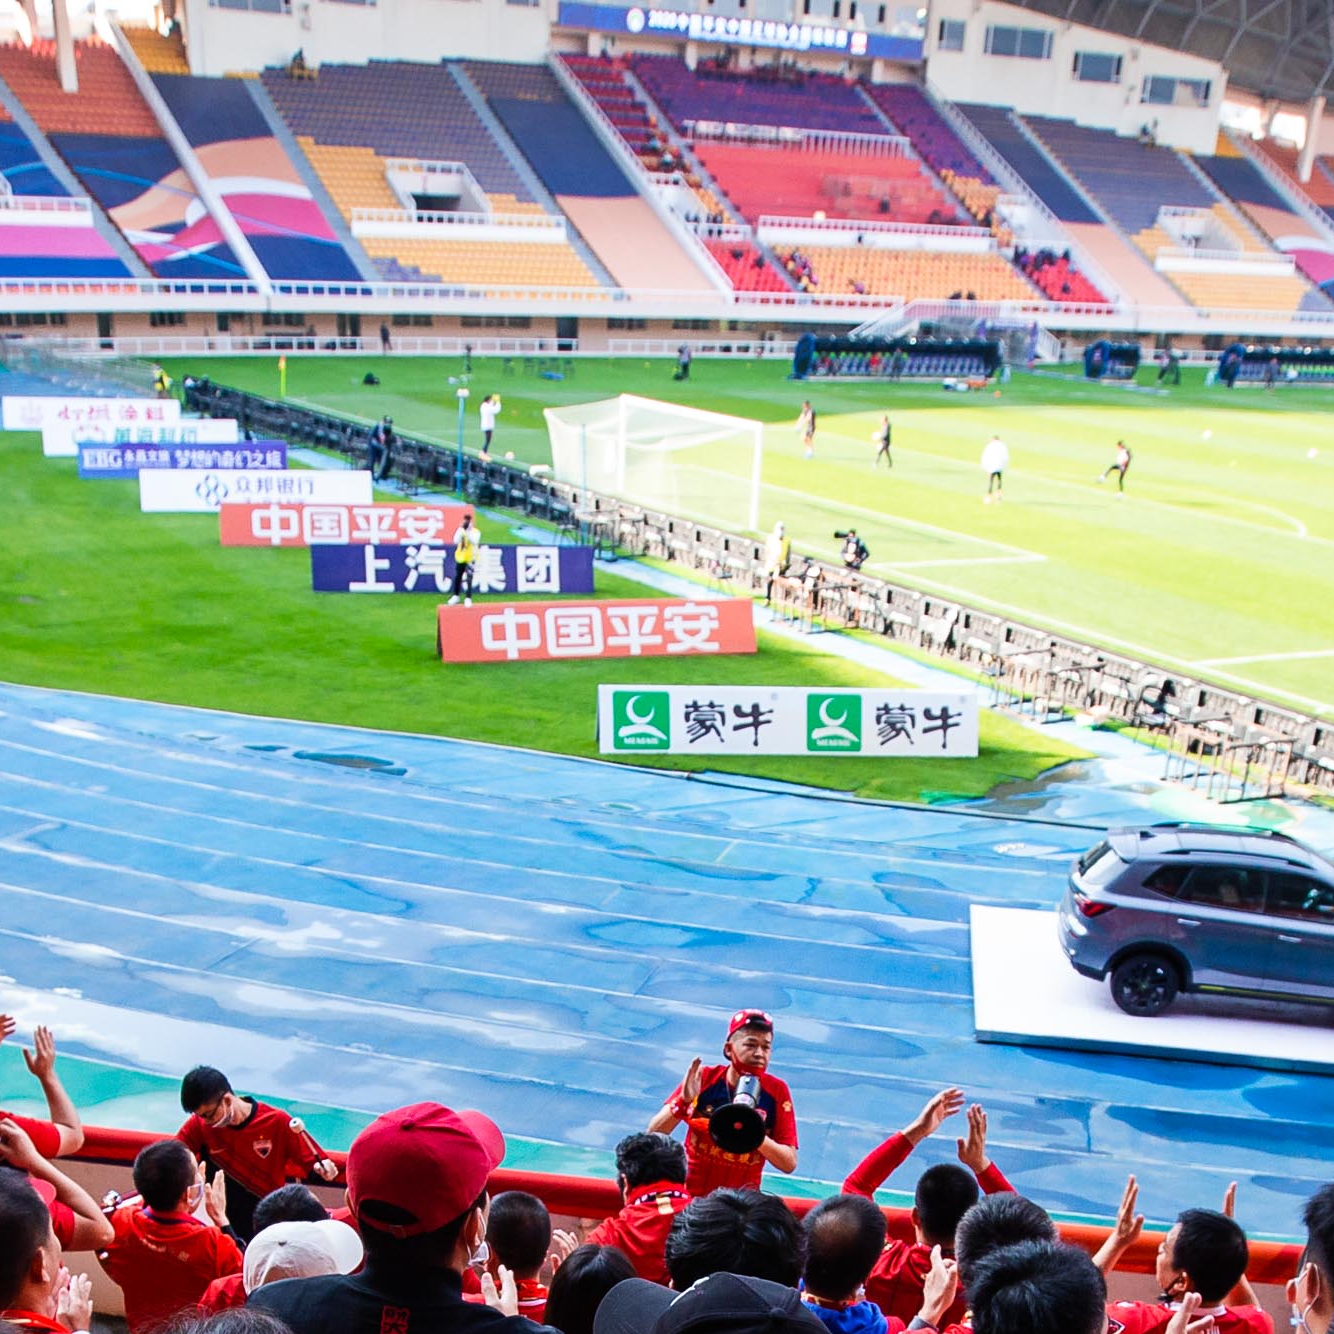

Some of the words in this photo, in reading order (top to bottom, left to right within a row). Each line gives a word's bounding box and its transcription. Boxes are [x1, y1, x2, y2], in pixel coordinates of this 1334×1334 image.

[236, 475, 315, 495] 众邦银行
[251, 504, 445, 545] 中国平安
[349, 545, 561, 593] 上汽集团
[481, 603, 720, 660] 中国平安
[684, 700, 774, 746] 蒙牛
[875, 702, 963, 749] 蒙牛
